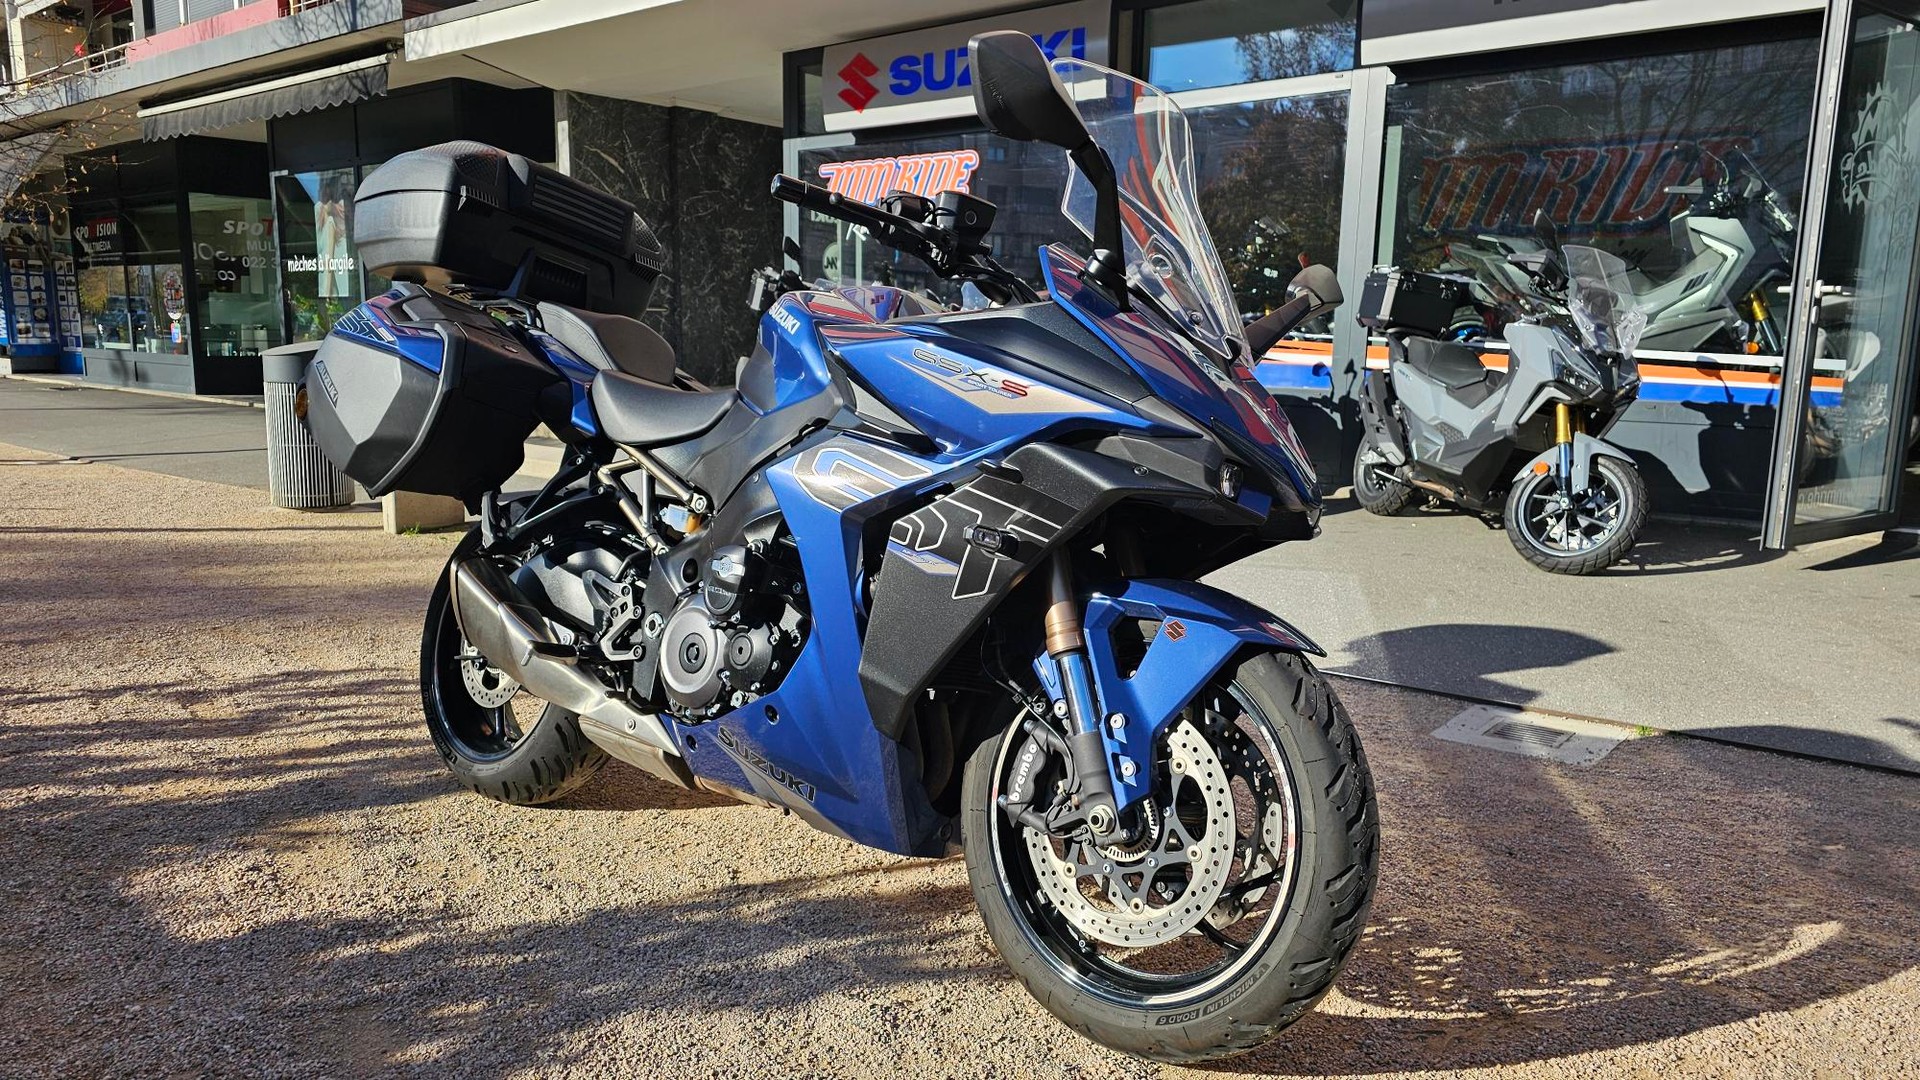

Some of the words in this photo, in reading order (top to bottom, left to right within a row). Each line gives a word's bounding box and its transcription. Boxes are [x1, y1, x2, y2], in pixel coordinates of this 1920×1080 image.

[889, 27, 1086, 96] SUZKI
[242, 256, 267, 269] 022
[287, 254, 318, 273] mèches
[768, 303, 800, 335] SUZUKI
[913, 348, 1029, 397] GSX-S
[717, 726, 816, 803] SUZUKI
[1008, 743, 1038, 802] brembo
[1206, 976, 1255, 1014] MICHELIN
[1159, 1015, 1167, 1026] 6
[1168, 1010, 1198, 1025] ROAD
